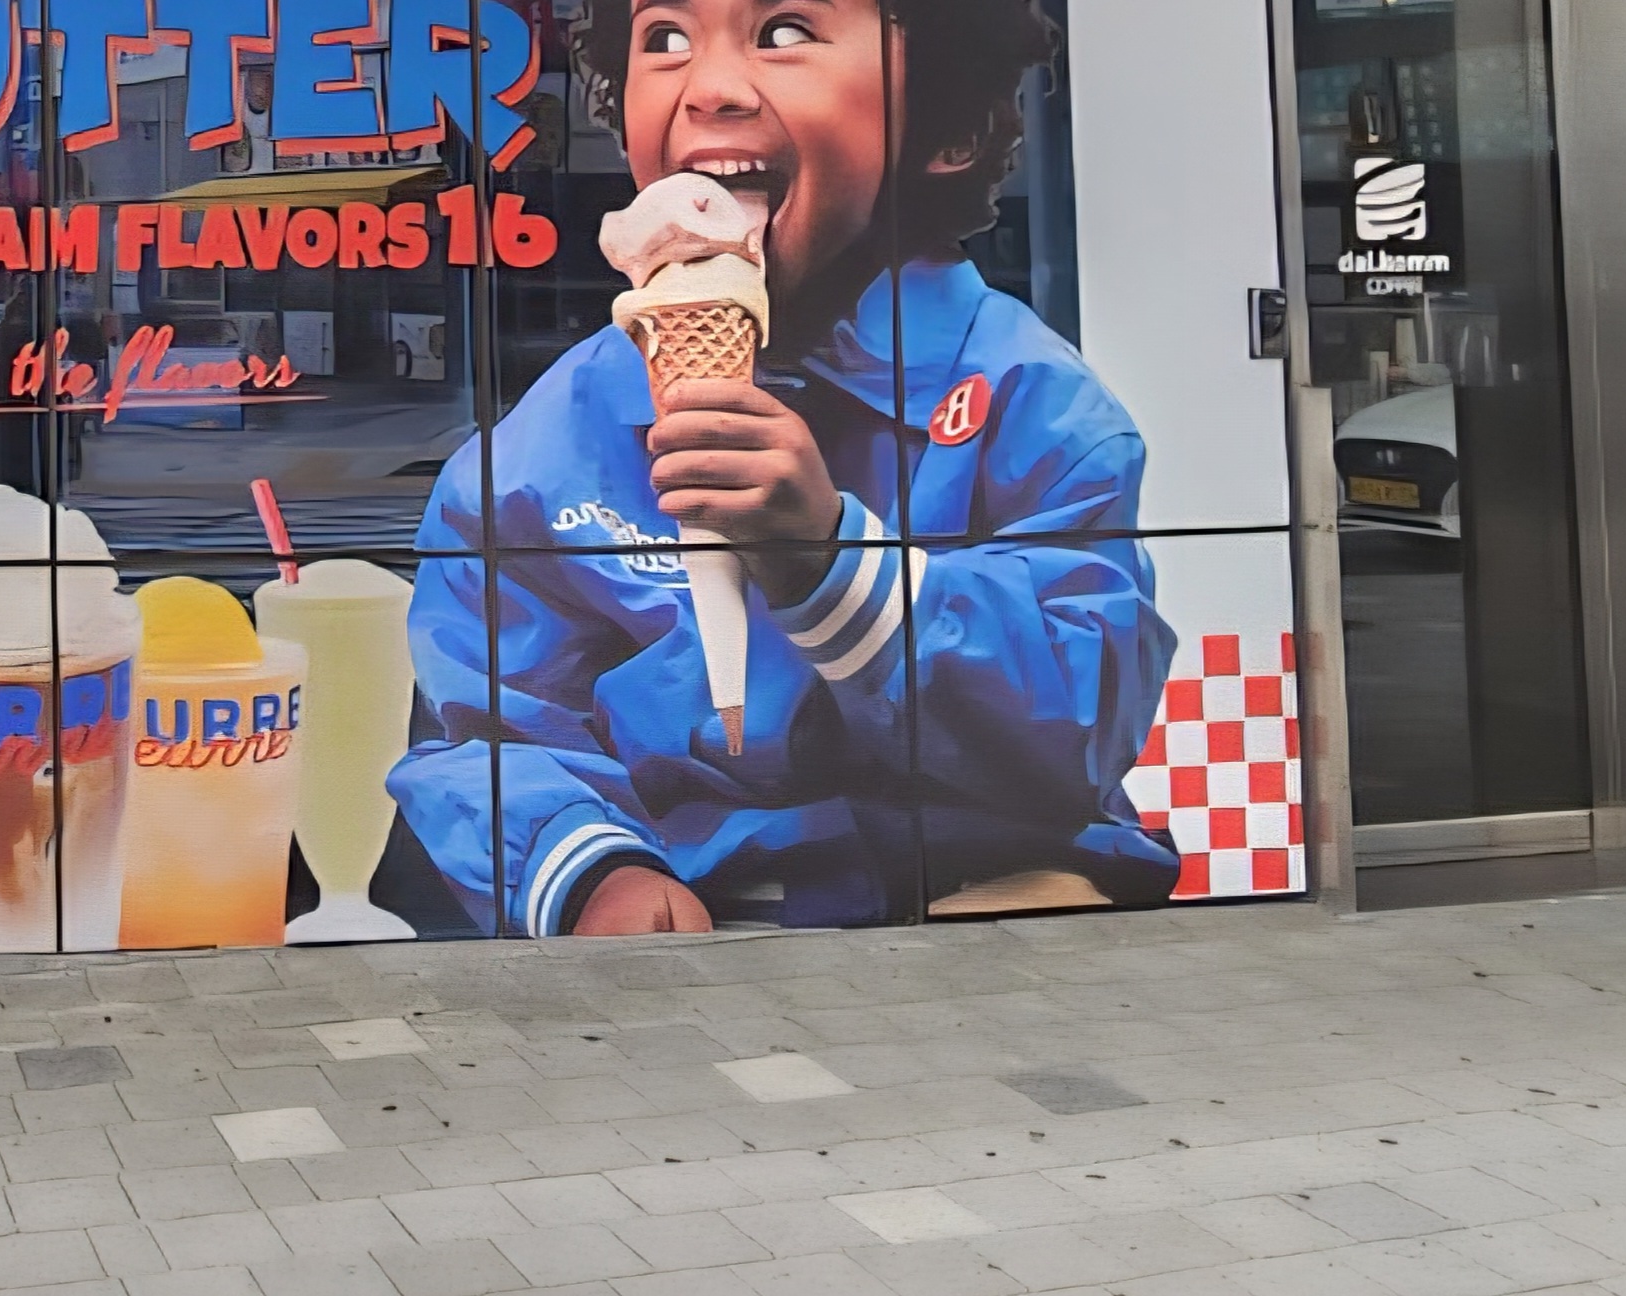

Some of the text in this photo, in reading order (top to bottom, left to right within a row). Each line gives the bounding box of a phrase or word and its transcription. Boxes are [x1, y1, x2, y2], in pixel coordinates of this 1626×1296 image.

[115, 202, 430, 272] FLAVORS
[437, 183, 558, 270] 16
[11, 326, 97, 397] the
